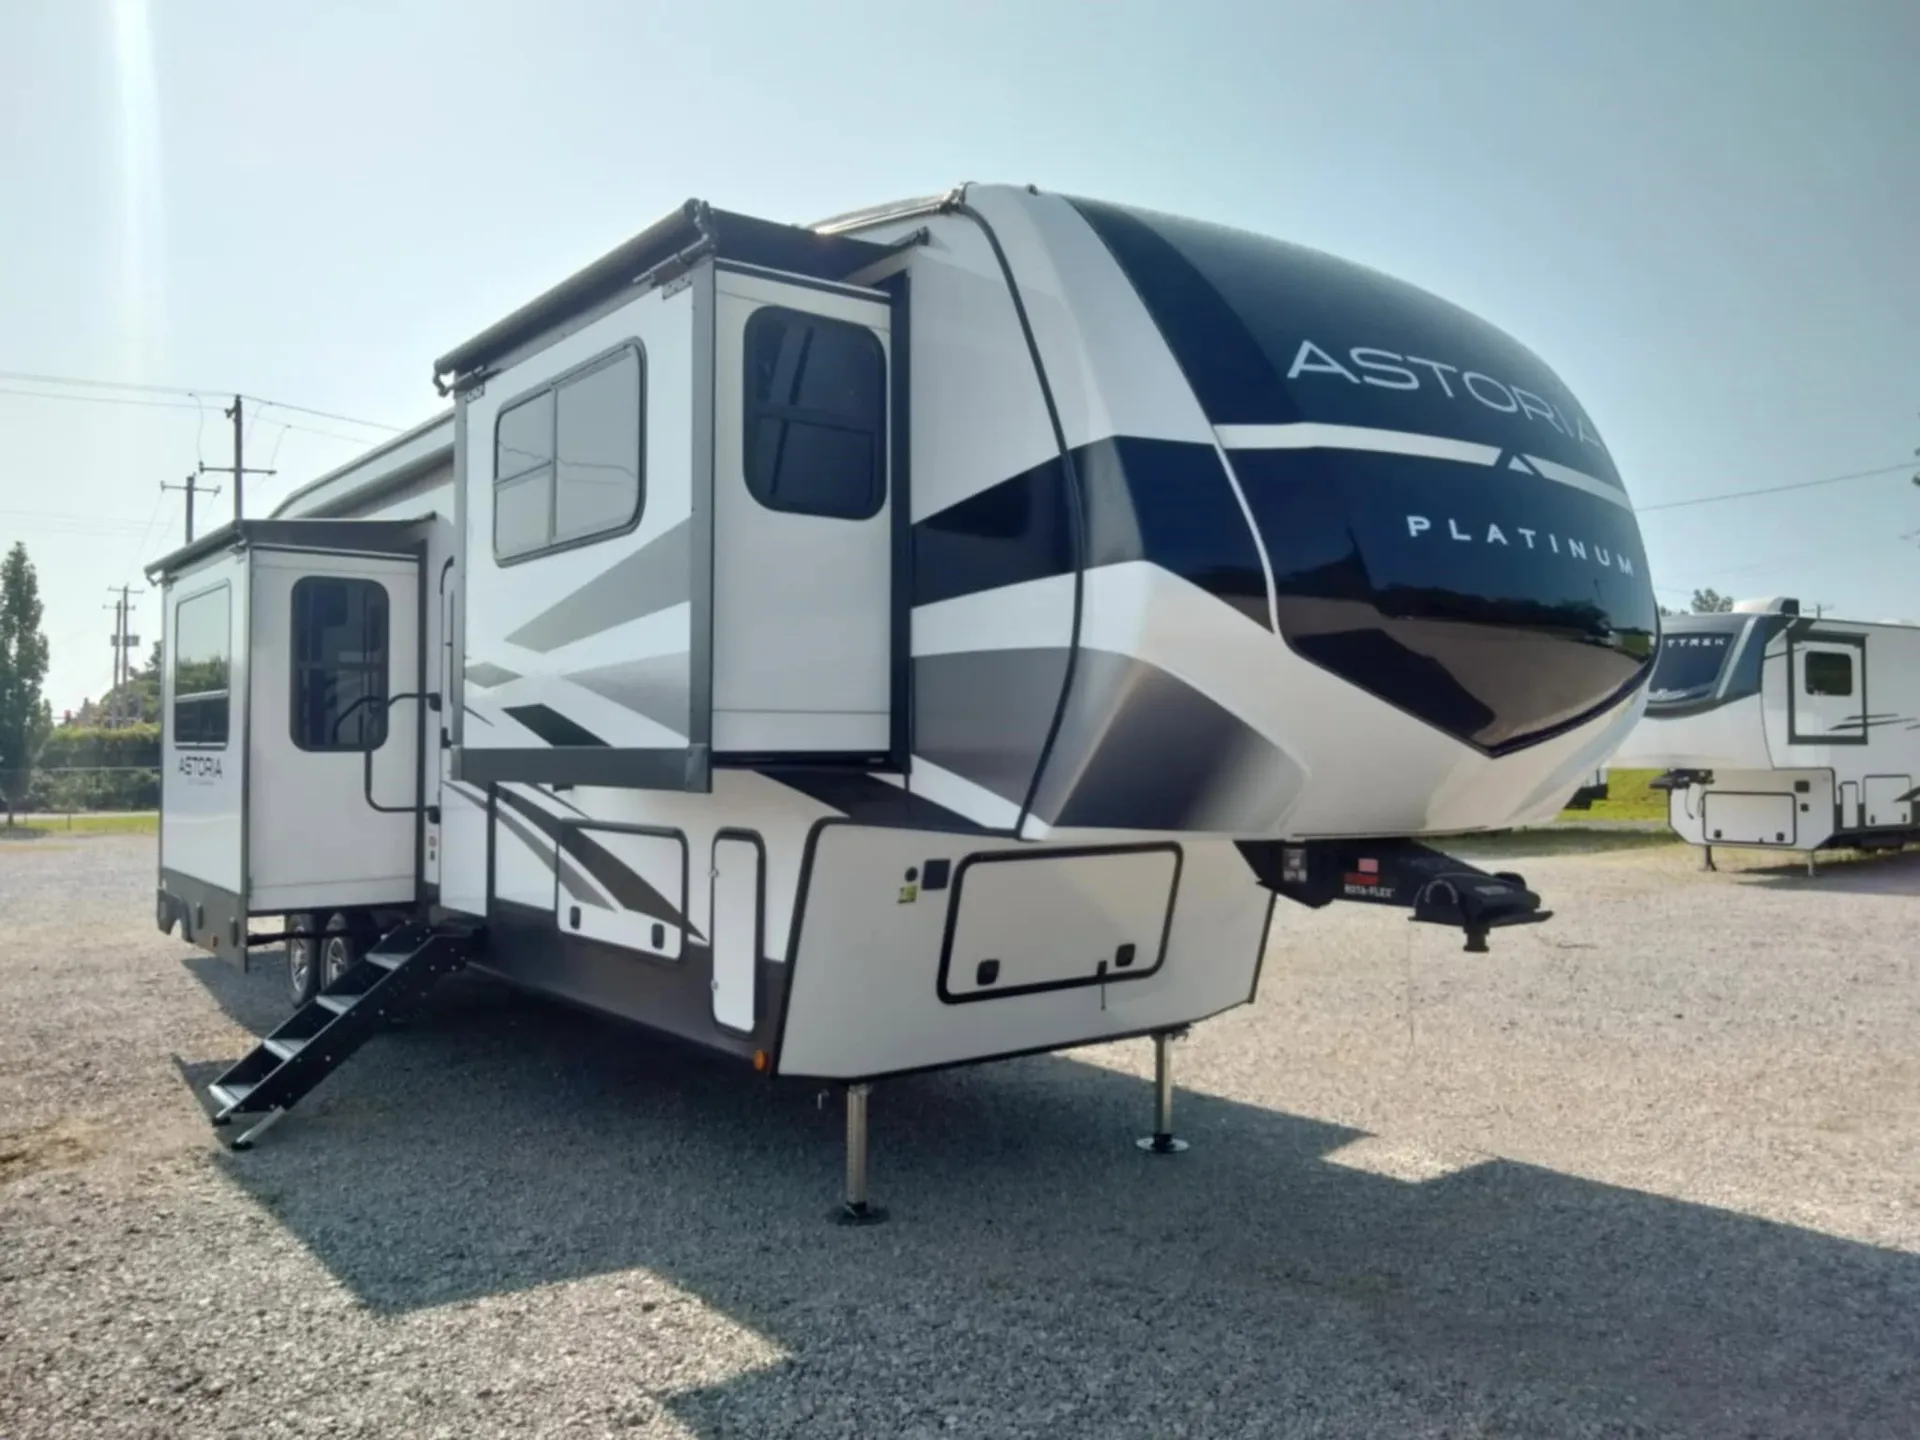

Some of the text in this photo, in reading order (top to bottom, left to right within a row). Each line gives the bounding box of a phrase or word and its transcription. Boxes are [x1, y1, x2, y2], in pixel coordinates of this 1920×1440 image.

[1287, 339, 1606, 451] ASTORIA
[1407, 515, 1634, 577] PLATINUM
[179, 756, 223, 779] ASTORIA
